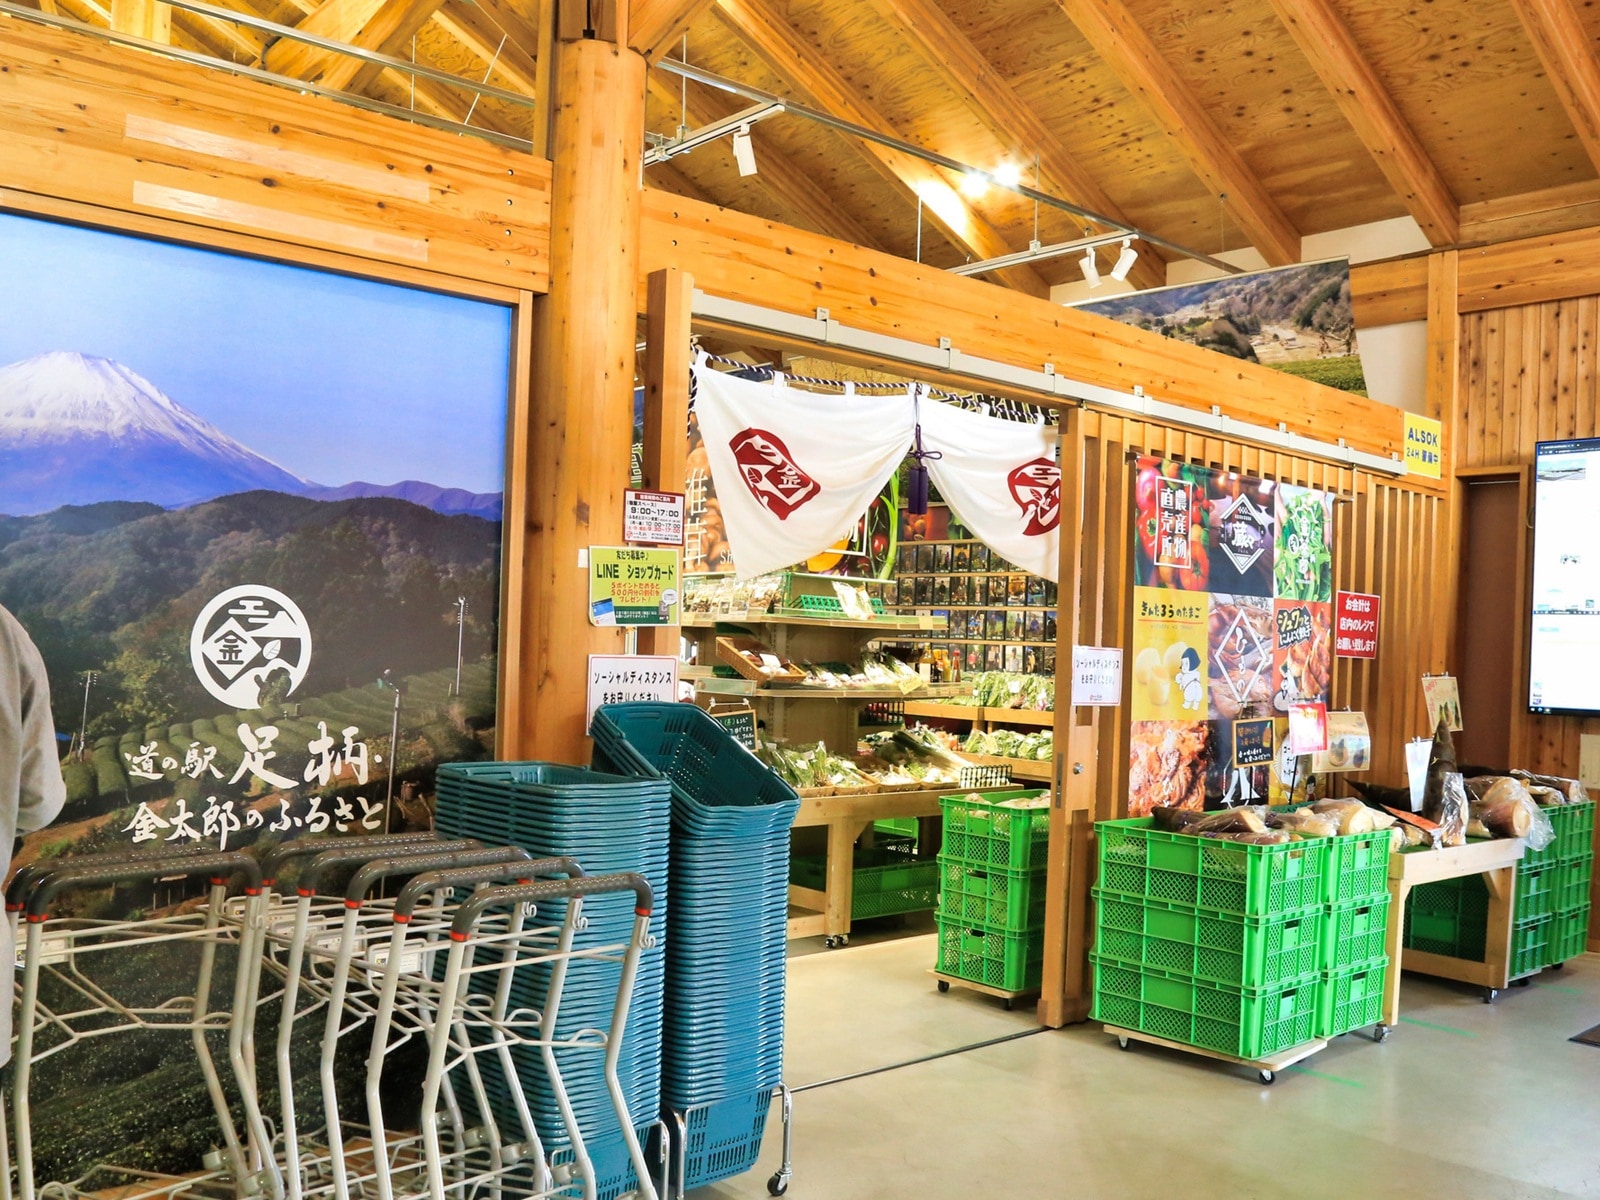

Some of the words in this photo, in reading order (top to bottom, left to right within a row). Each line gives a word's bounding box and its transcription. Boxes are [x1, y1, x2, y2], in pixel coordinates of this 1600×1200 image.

[1407, 427, 1438, 448] ALSOK
[1406, 446, 1420, 460] 24H
[1159, 487, 1174, 557] 直売所
[1174, 488, 1188, 559] 農産物
[596, 563, 620, 579] LINE
[626, 564, 675, 580] ショップカード
[1345, 597, 1371, 613] お会計は
[1339, 616, 1375, 633] 店内のレジで
[594, 670, 673, 685] ソーシャルディスタンス
[121, 796, 384, 851] 金太郎のふるさと
